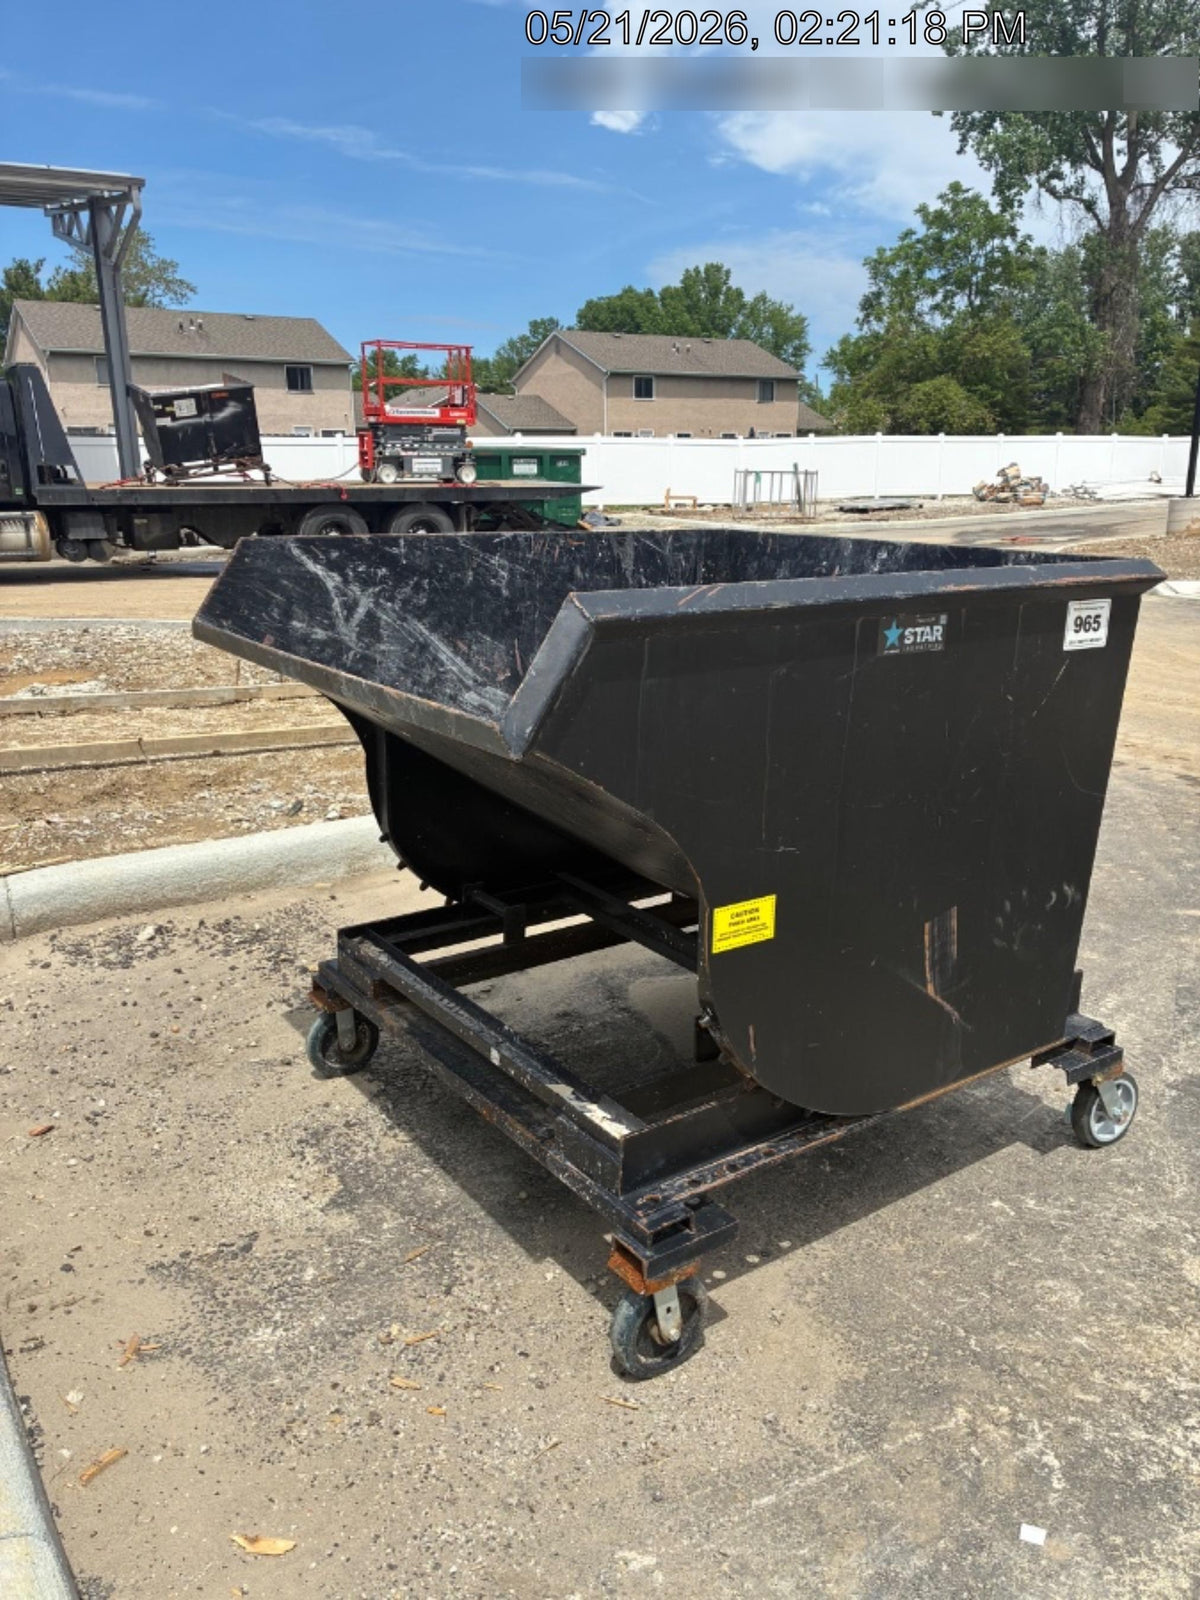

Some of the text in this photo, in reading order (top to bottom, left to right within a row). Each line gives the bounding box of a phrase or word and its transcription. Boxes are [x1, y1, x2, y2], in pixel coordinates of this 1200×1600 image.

[1073, 613, 1102, 634] 965
[904, 625, 943, 645] STAR
[730, 907, 760, 920] CAUTION
